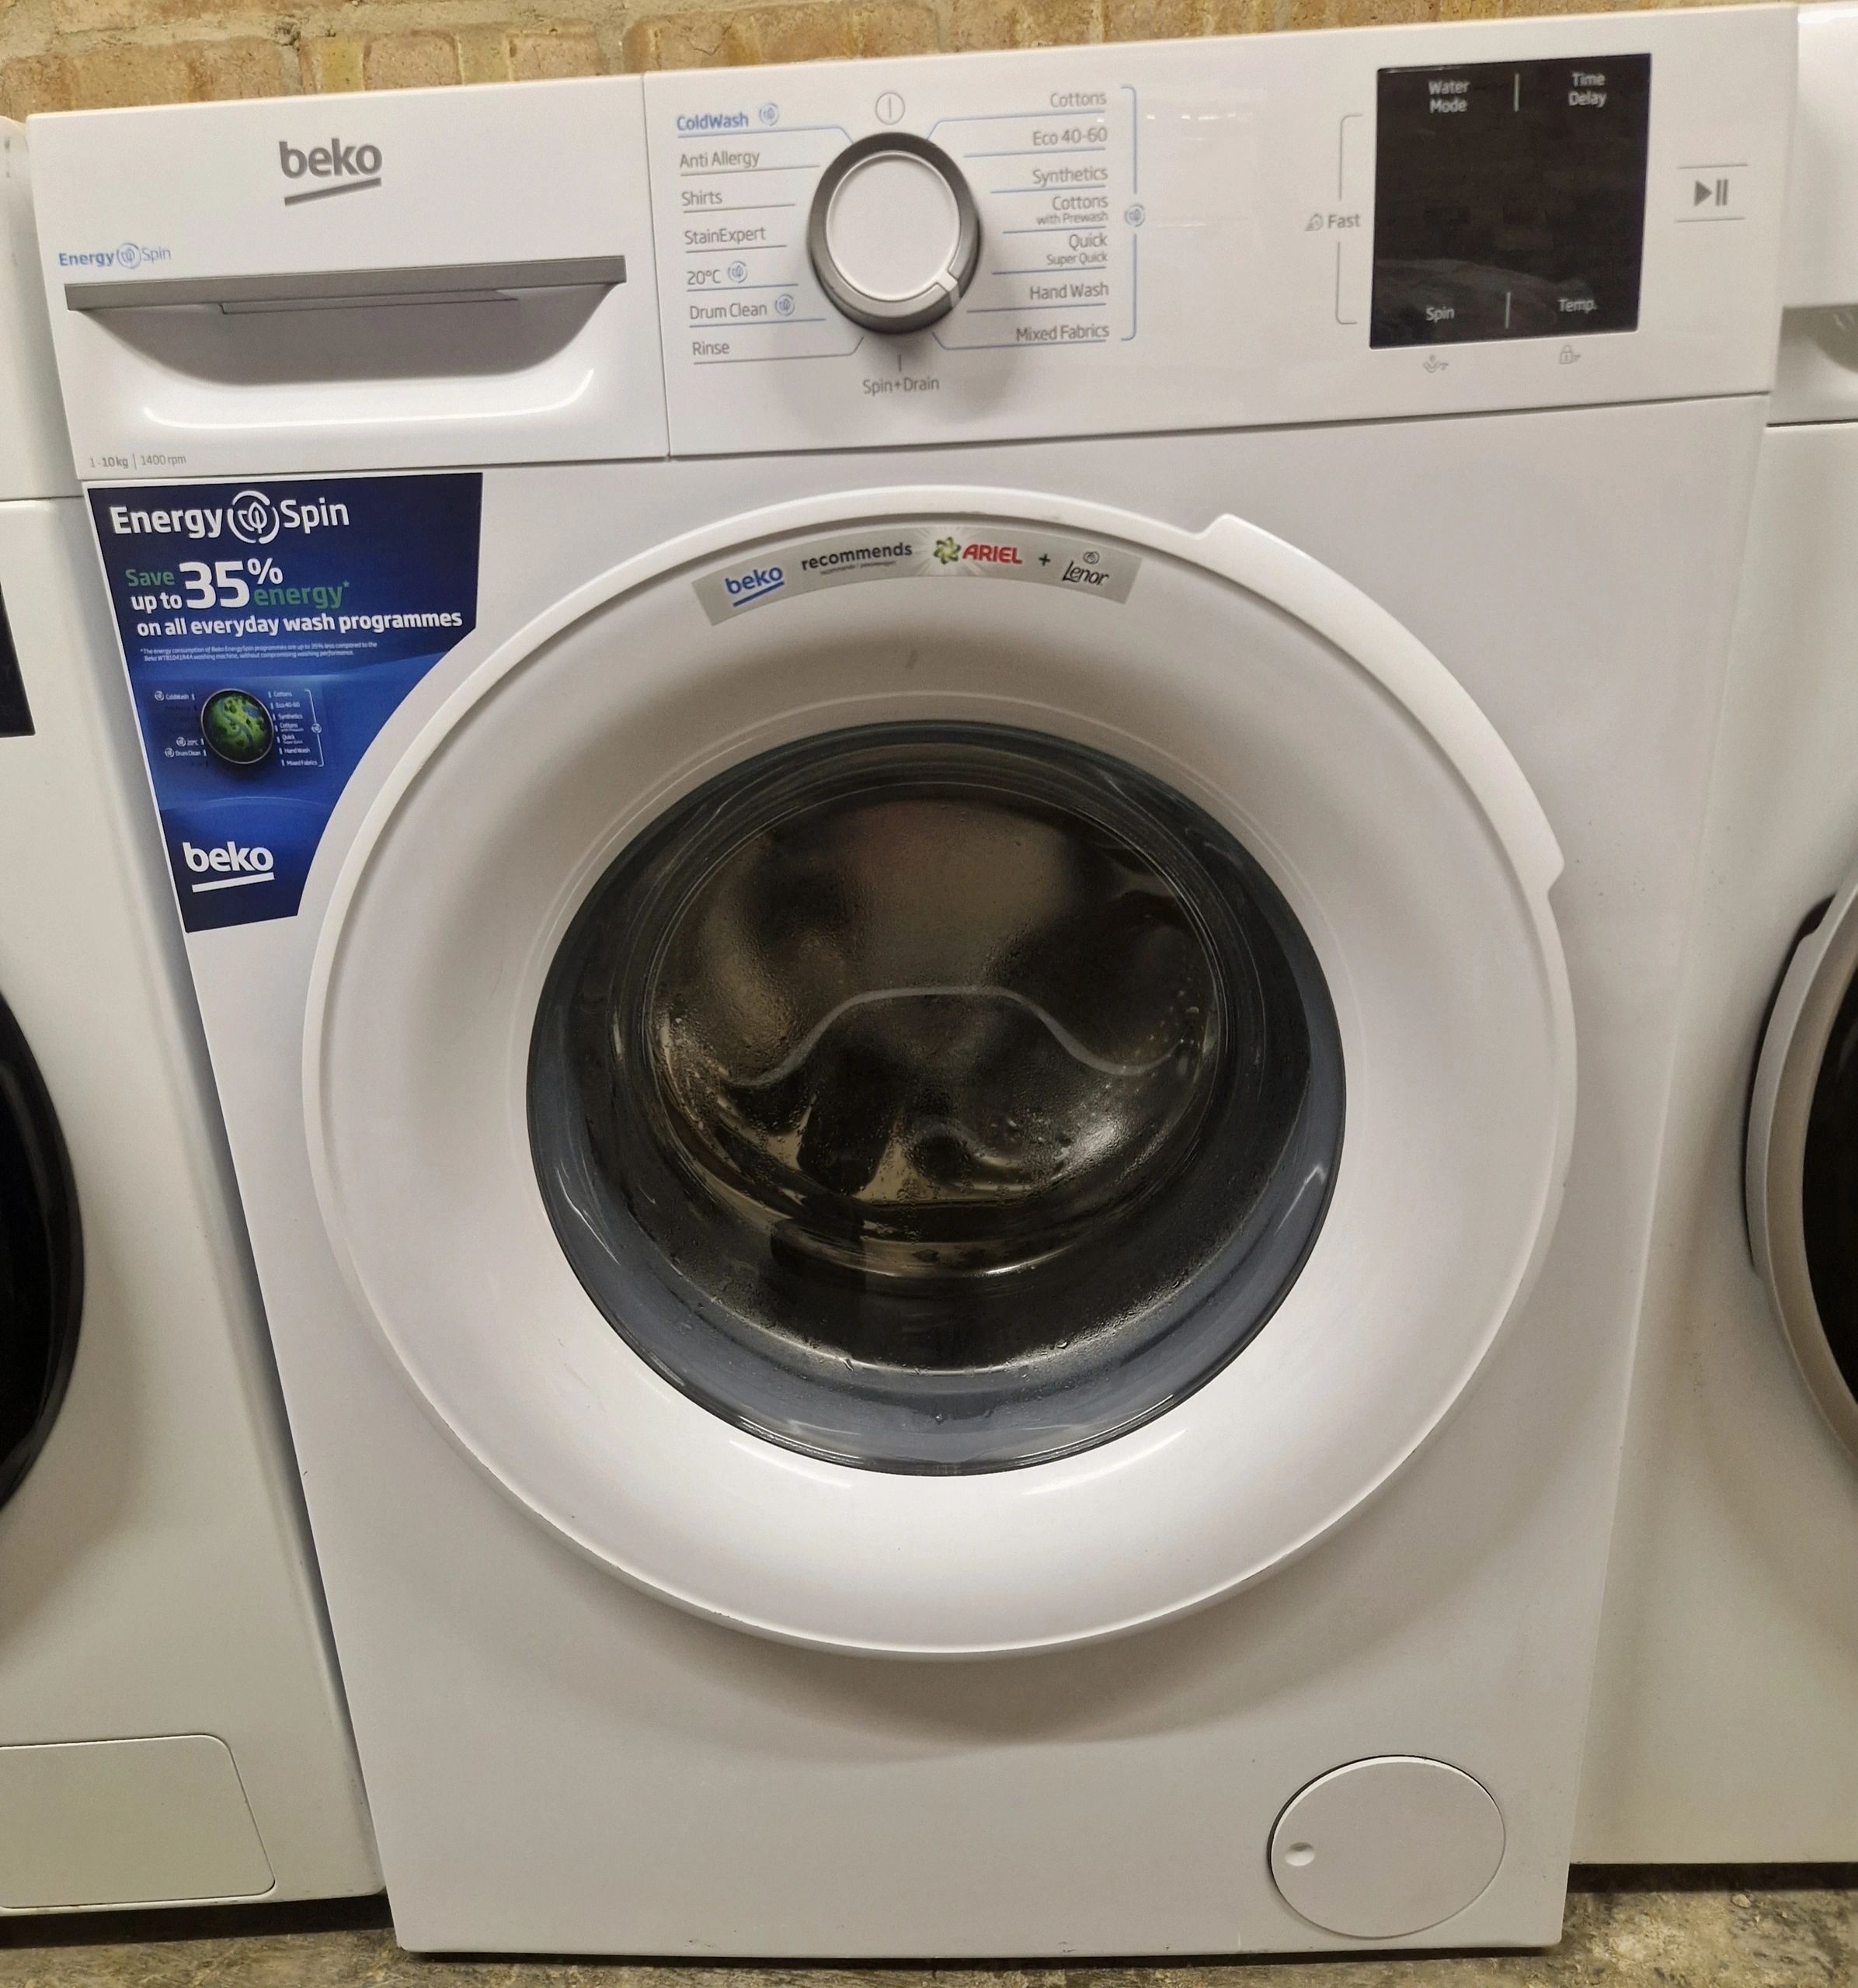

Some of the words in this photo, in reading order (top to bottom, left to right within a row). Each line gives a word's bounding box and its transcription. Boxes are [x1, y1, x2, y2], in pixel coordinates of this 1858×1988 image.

[1428, 78, 1470, 95] Water
[1571, 71, 1606, 87] Time
[1050, 92, 1108, 108] Cottons
[1429, 97, 1468, 113] Mode
[1567, 90, 1608, 108] Delay
[677, 112, 749, 130] ColdWash
[1032, 130, 1058, 146] Eco
[1061, 127, 1108, 144] 40-60
[279, 137, 383, 179] beko
[680, 152, 708, 169] Anti
[712, 151, 760, 169] Allergy
[1032, 166, 1108, 188] Synthetics
[681, 190, 722, 207] Shirts
[1053, 195, 1108, 211] Cottons
[1037, 213, 1061, 225] with
[1063, 211, 1108, 224] Prewash
[1327, 213, 1360, 229] Fast
[684, 227, 766, 245] StainExpert
[1069, 232, 1108, 251] Quick
[58, 252, 115, 267] Energy
[141, 246, 172, 263] Spin
[1046, 253, 1077, 266] Super
[1079, 252, 1108, 265] Quick
[687, 269, 721, 285] 20°C
[1030, 284, 1067, 300] Hand
[1070, 282, 1109, 297] Wash
[690, 305, 726, 320] Drum
[729, 303, 767, 316] Clean
[1425, 306, 1455, 323] Spin
[1558, 297, 1598, 314] Temp.
[1016, 325, 1057, 342] Mixed
[1060, 323, 1110, 339] Fabrics
[692, 341, 730, 356] Rinse
[109, 506, 223, 539] Energy
[280, 497, 350, 534] Spin
[725, 567, 783, 594] beko
[802, 541, 913, 571] recommends
[962, 544, 1023, 565] ARIEL
[1062, 560, 1110, 586] Lenor
[125, 568, 176, 586] Save
[130, 594, 158, 613] up
[159, 592, 183, 610] to
[179, 558, 284, 610] 35%
[137, 622, 162, 637] on
[165, 617, 187, 636] all
[190, 615, 279, 638] everyday
[283, 613, 335, 631] wash
[339, 611, 463, 634] programmes
[183, 841, 273, 873] beko
